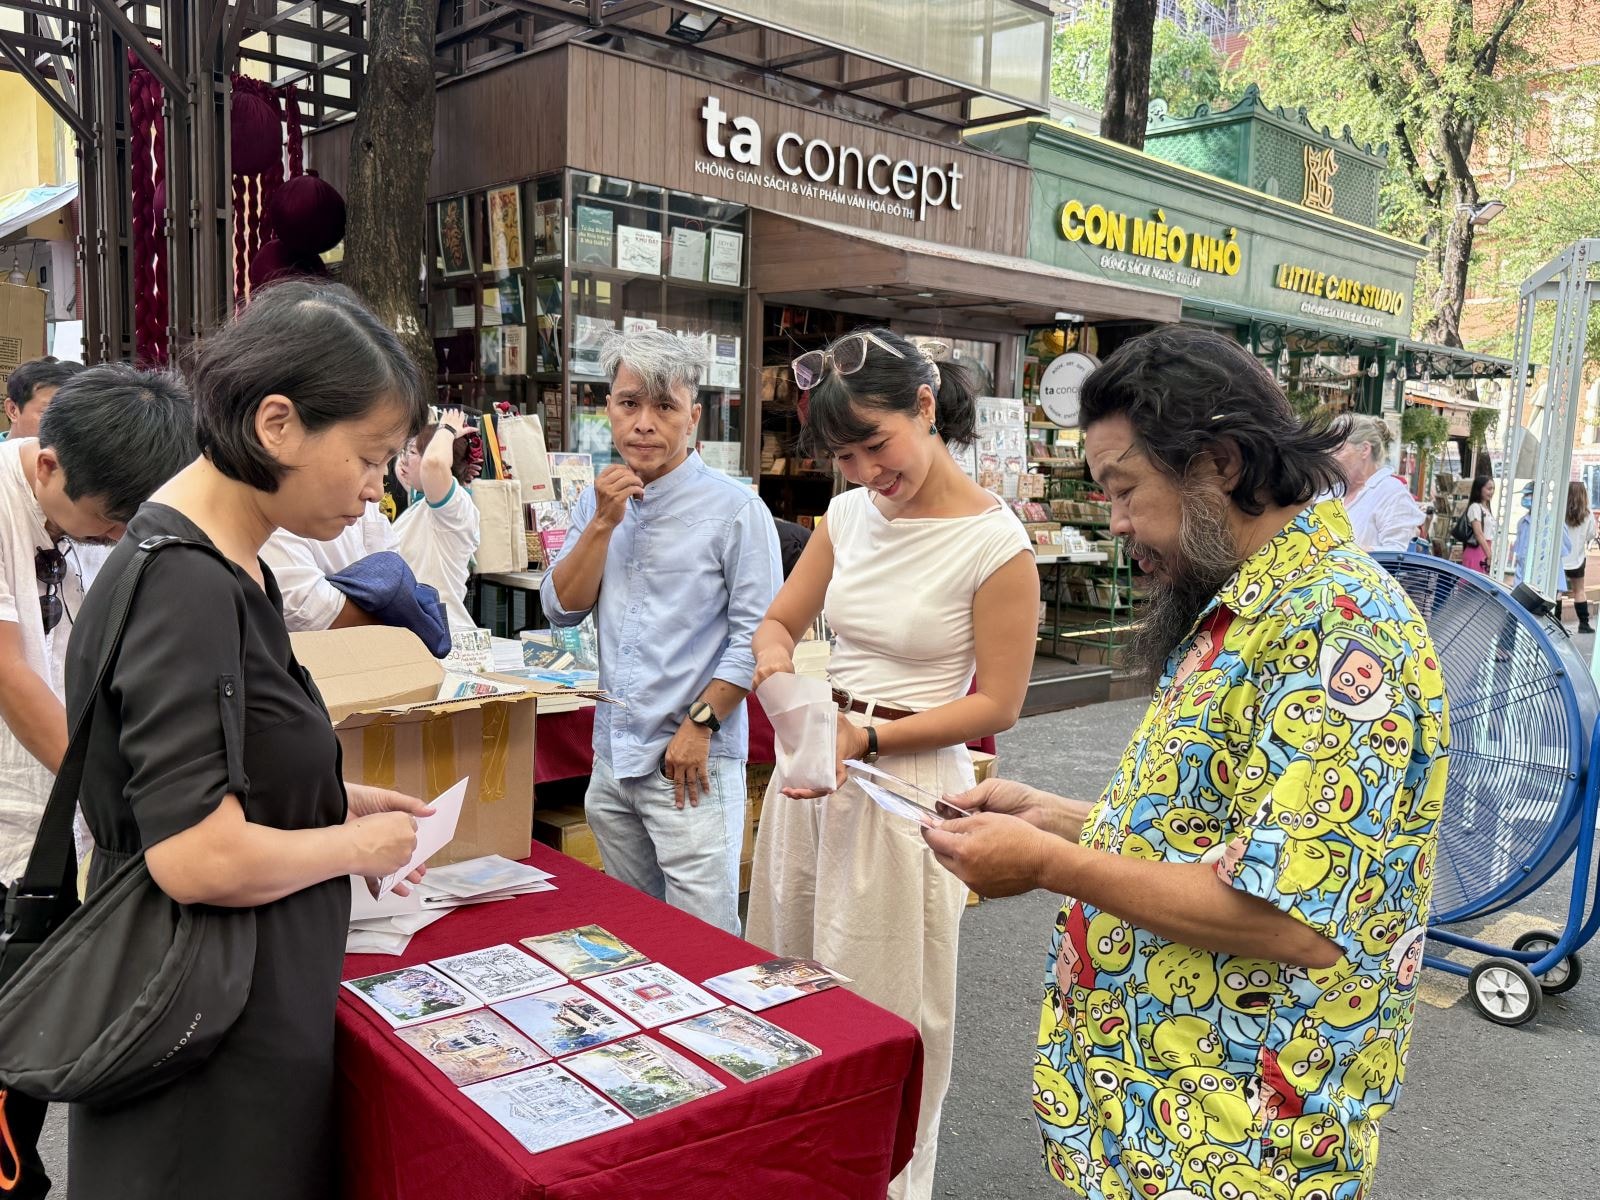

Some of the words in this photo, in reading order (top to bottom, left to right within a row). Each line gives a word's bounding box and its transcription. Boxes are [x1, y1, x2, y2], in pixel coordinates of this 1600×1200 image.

[701, 96, 762, 166] ta
[776, 132, 963, 221] concept
[694, 160, 735, 180] KHÔNG
[736, 171, 762, 185] GIAN
[763, 174, 790, 191] SÁCH
[791, 183, 799, 194] &
[800, 184, 818, 200] VẬT
[819, 188, 846, 205] PHẨM
[847, 193, 866, 208] VĂN
[866, 196, 887, 213] HOÁ
[887, 200, 901, 217] ĐÔ
[1061, 199, 1127, 252] CON
[1132, 208, 1187, 264] MÈO
[1190, 227, 1242, 276] NHỎ
[1127, 259, 1150, 277] SÁCH
[1278, 262, 1325, 297] LITTLE
[1325, 274, 1361, 305] CATS
[1361, 283, 1406, 316] STUDIO
[1045, 386, 1055, 395] ta
